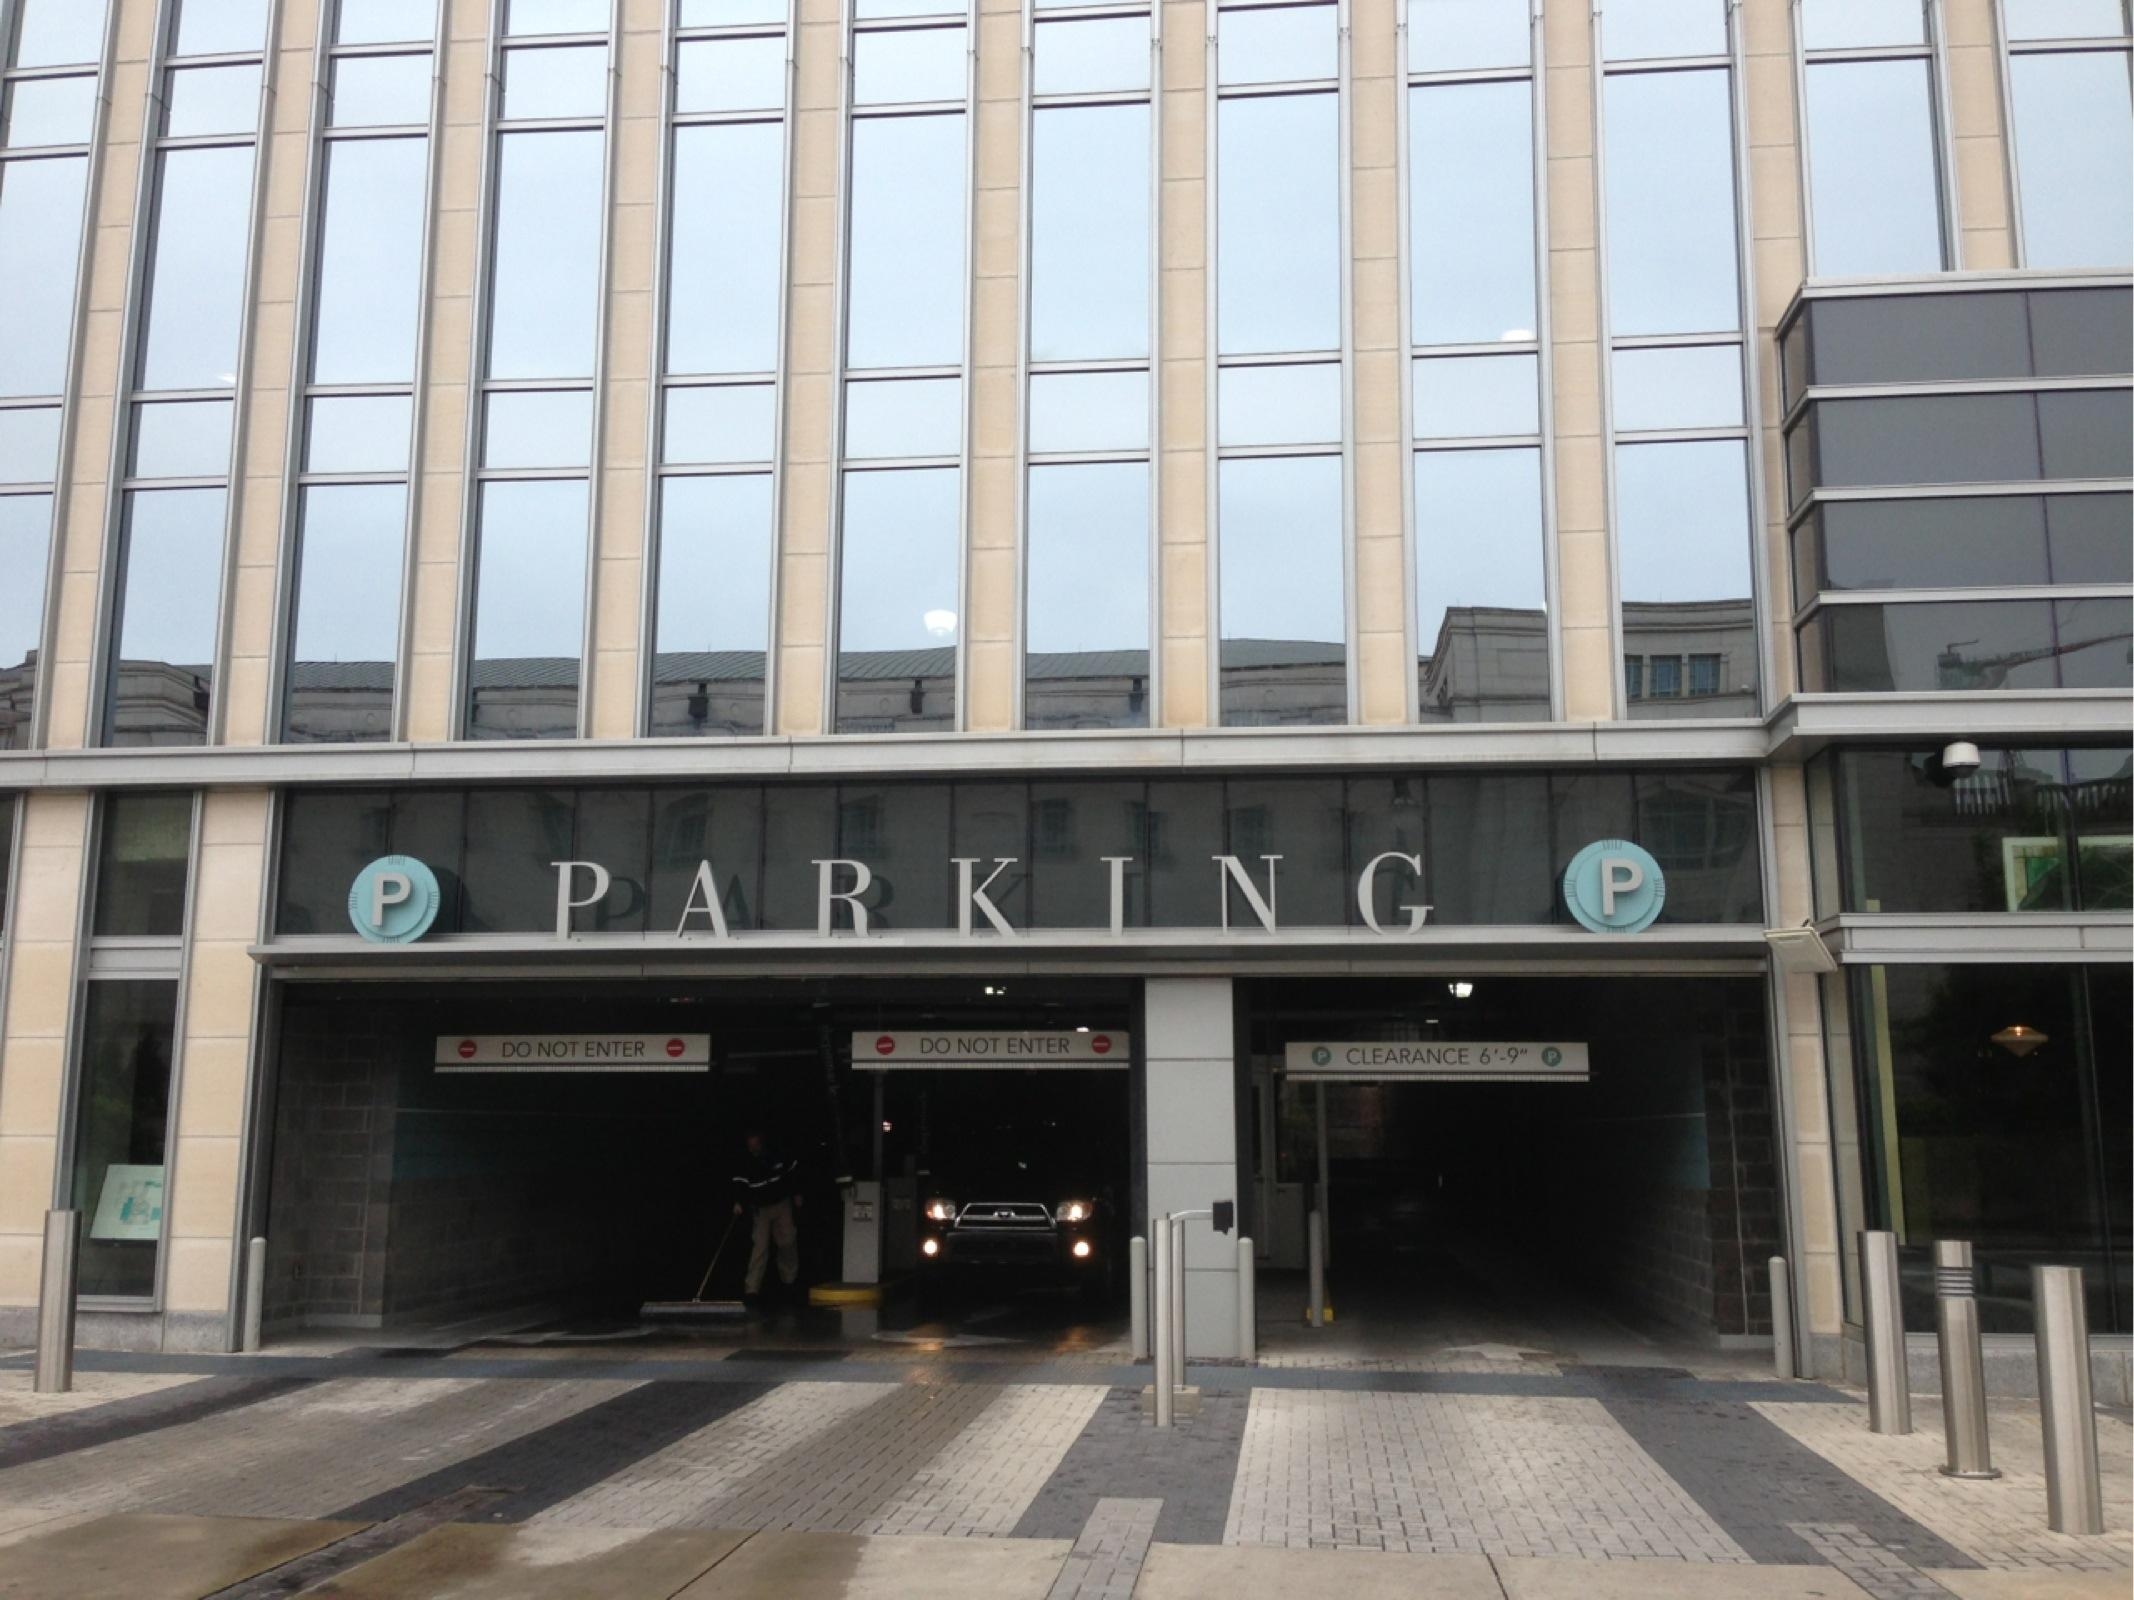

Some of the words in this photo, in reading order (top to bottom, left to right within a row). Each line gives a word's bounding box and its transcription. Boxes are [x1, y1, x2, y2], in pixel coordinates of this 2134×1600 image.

[372, 872, 411, 927] P
[550, 851, 1434, 940] PARKING
[1601, 858, 1643, 915] P
[502, 1041, 532, 1058] DO
[537, 1041, 578, 1057] NOT
[585, 1040, 645, 1057] ENTER
[920, 1038, 951, 1054] DO
[957, 1038, 1001, 1054] NOT
[1007, 1037, 1070, 1054] ENTER
[1346, 1047, 1469, 1065] CLEARANCE
